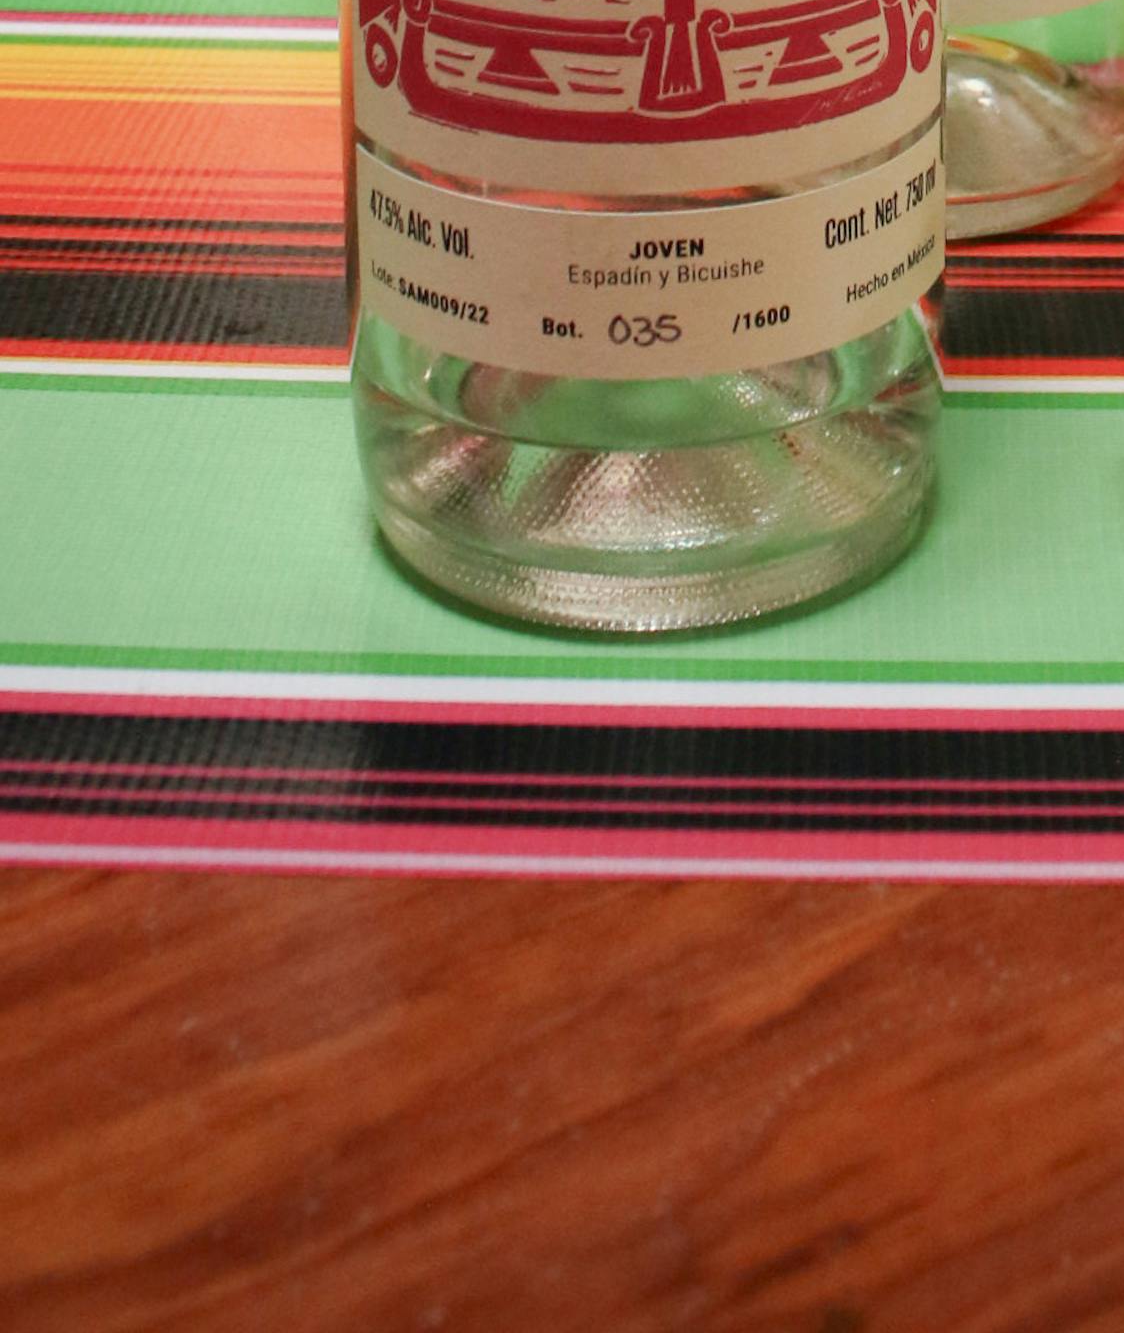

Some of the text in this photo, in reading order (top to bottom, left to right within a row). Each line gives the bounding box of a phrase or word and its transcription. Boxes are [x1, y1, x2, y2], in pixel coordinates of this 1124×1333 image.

[406, 209, 437, 249] Alc.
[440, 220, 475, 260] Vol.
[824, 206, 870, 249] Cont.
[874, 189, 902, 230] Net.
[628, 238, 706, 260] JOVEN
[567, 257, 766, 289] Espadín y Bicuishe
[845, 273, 889, 304] Hecho
[891, 262, 906, 282] en
[398, 276, 491, 325] SAM009/22
[541, 304, 791, 347] Bot. 035 /1600
